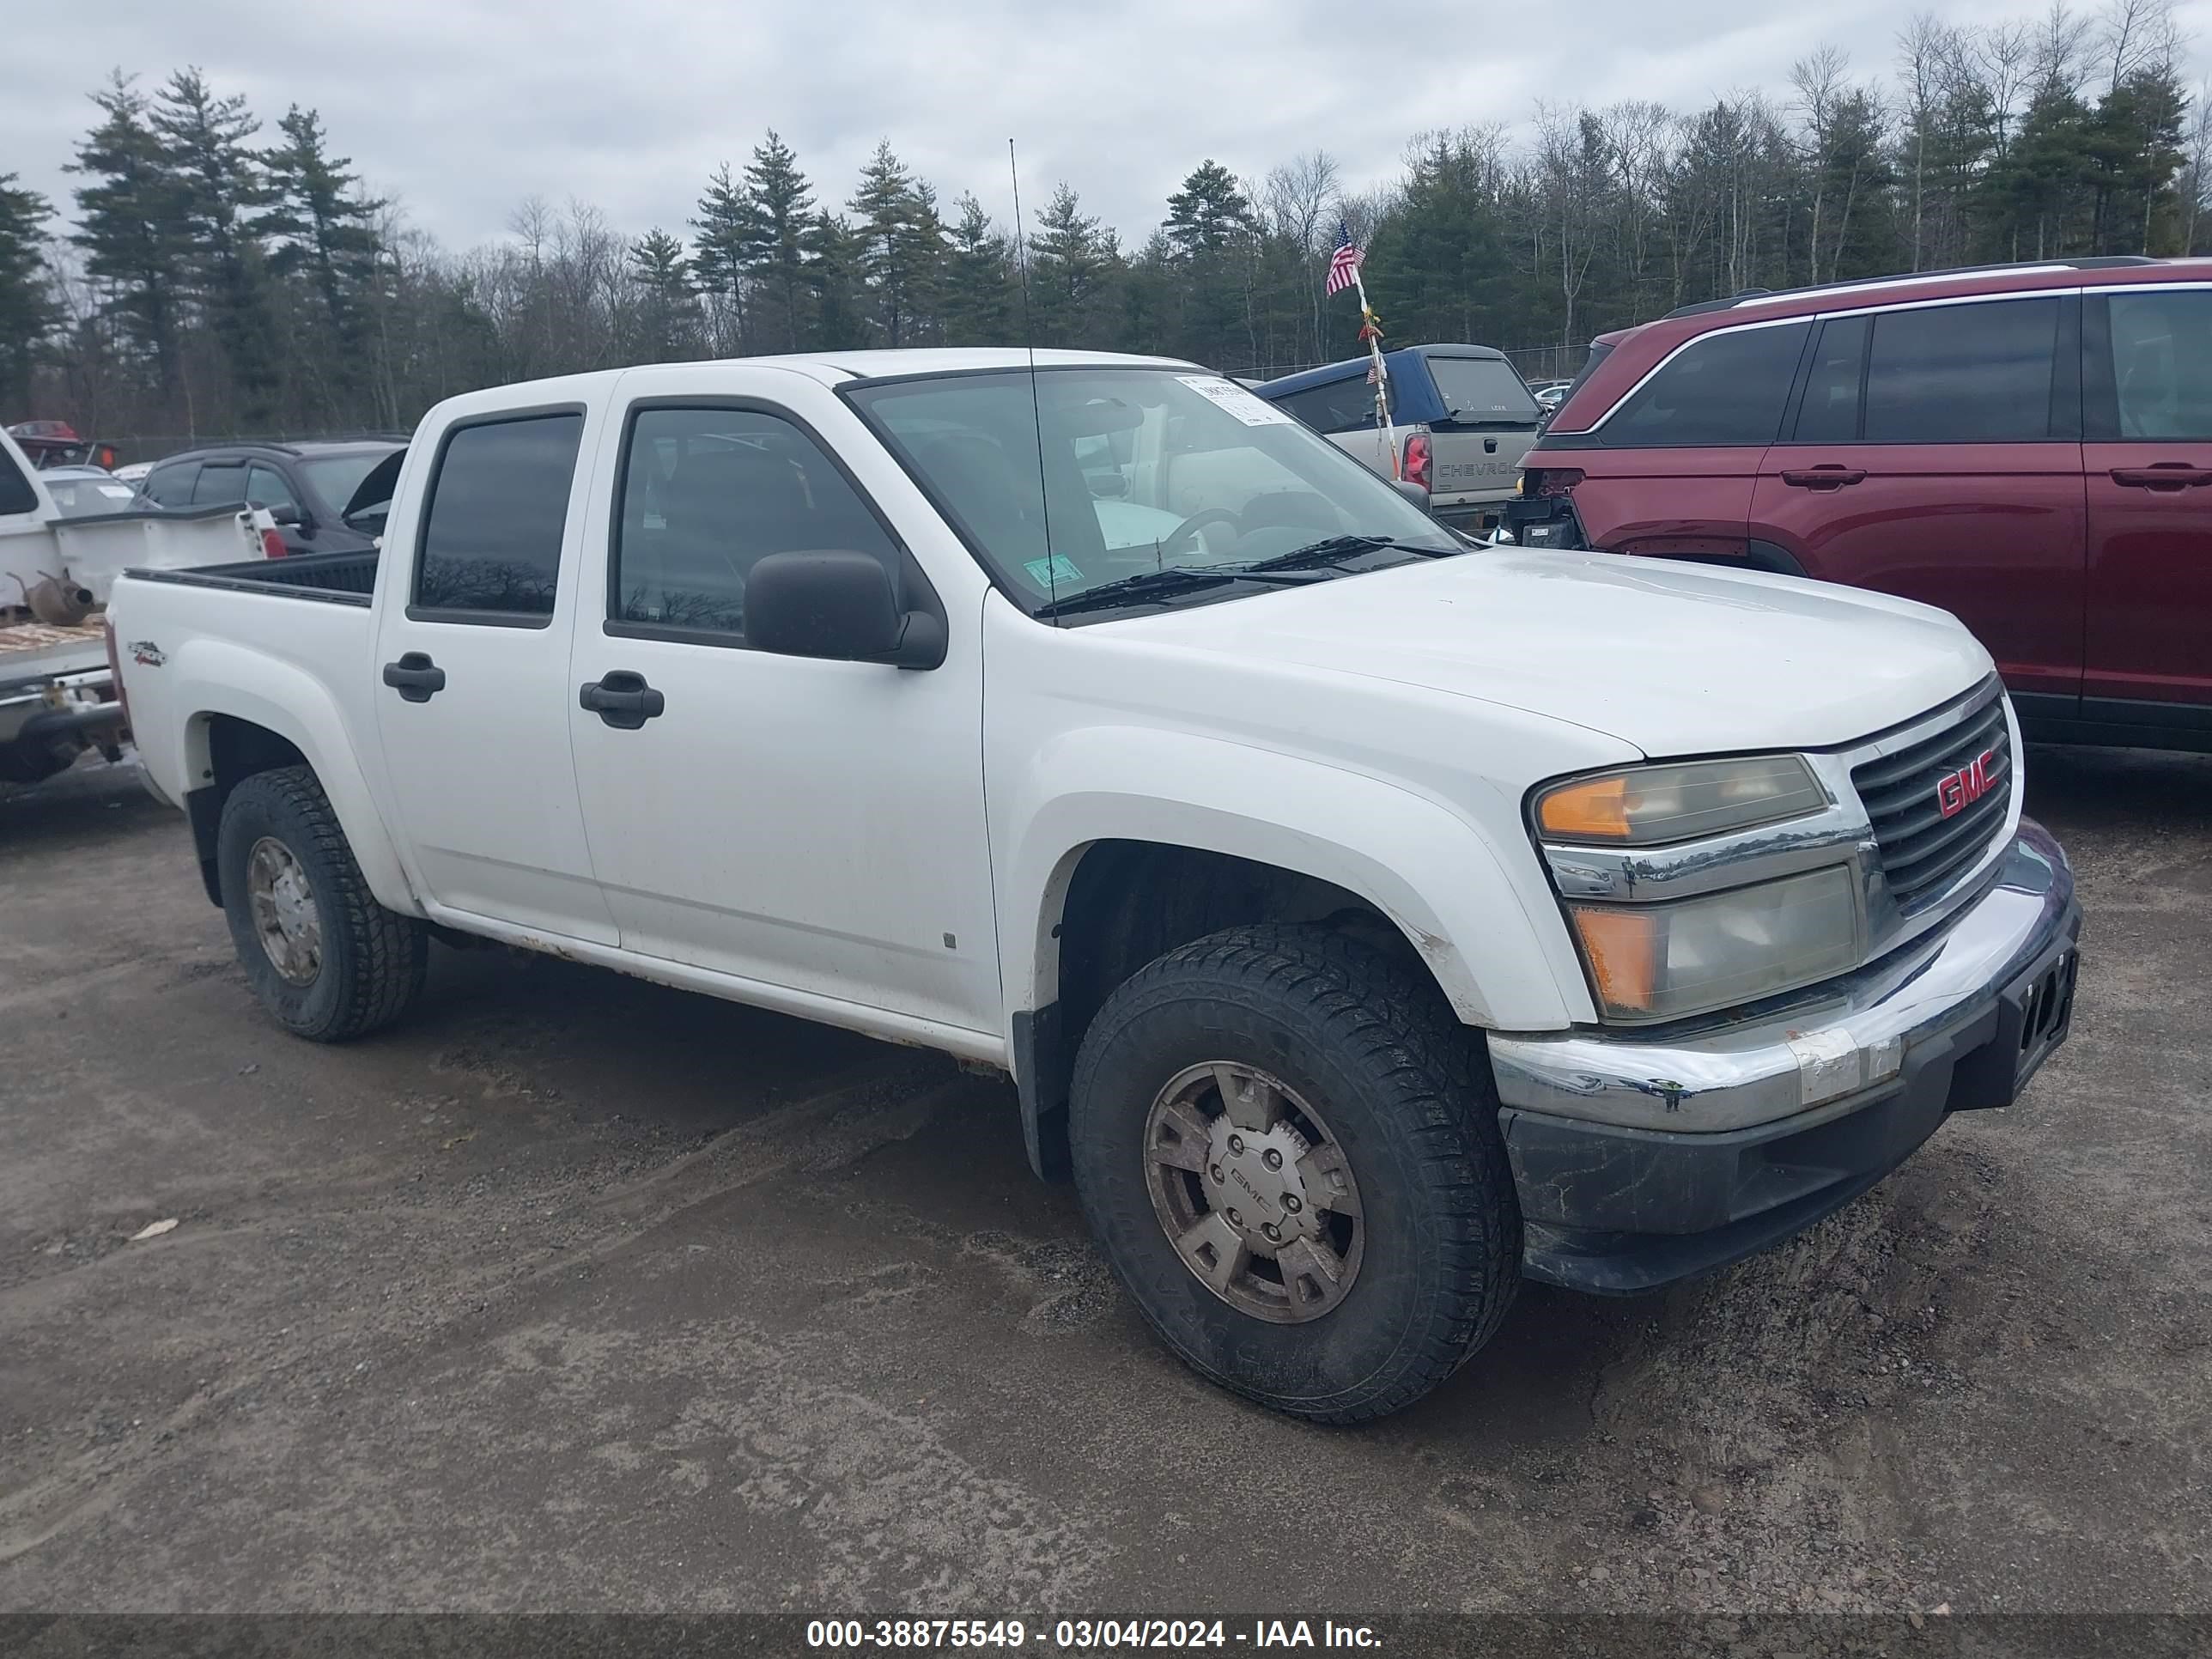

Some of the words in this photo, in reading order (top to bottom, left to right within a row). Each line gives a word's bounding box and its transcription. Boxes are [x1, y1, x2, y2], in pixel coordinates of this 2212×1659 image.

[1439, 462, 1525, 477] CHEVROL
[1937, 750, 1997, 819] GMC
[1231, 1168, 1272, 1213] GMC
